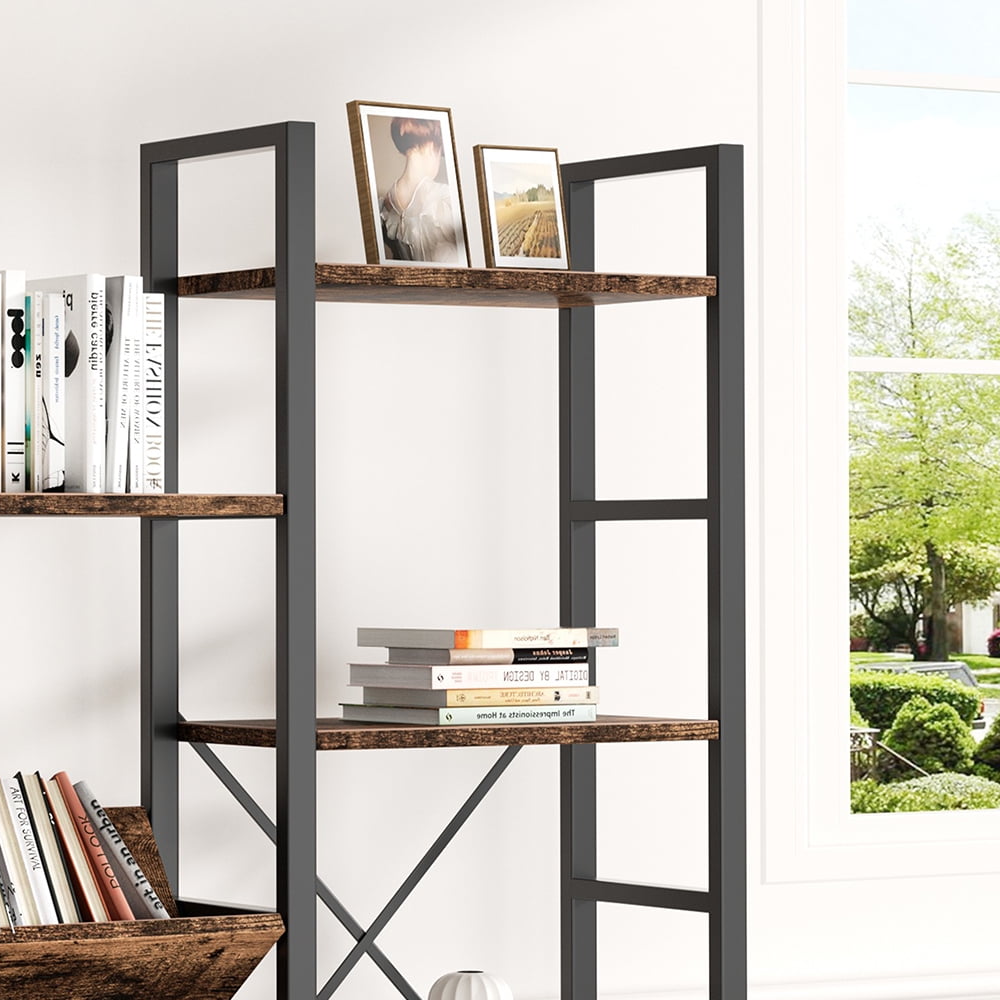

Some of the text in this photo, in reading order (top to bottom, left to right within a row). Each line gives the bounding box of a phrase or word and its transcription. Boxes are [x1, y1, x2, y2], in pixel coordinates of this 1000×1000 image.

[10, 786, 20, 805] ART
[16, 807, 28, 827] FOR
[90, 799, 163, 910] art in an urban
